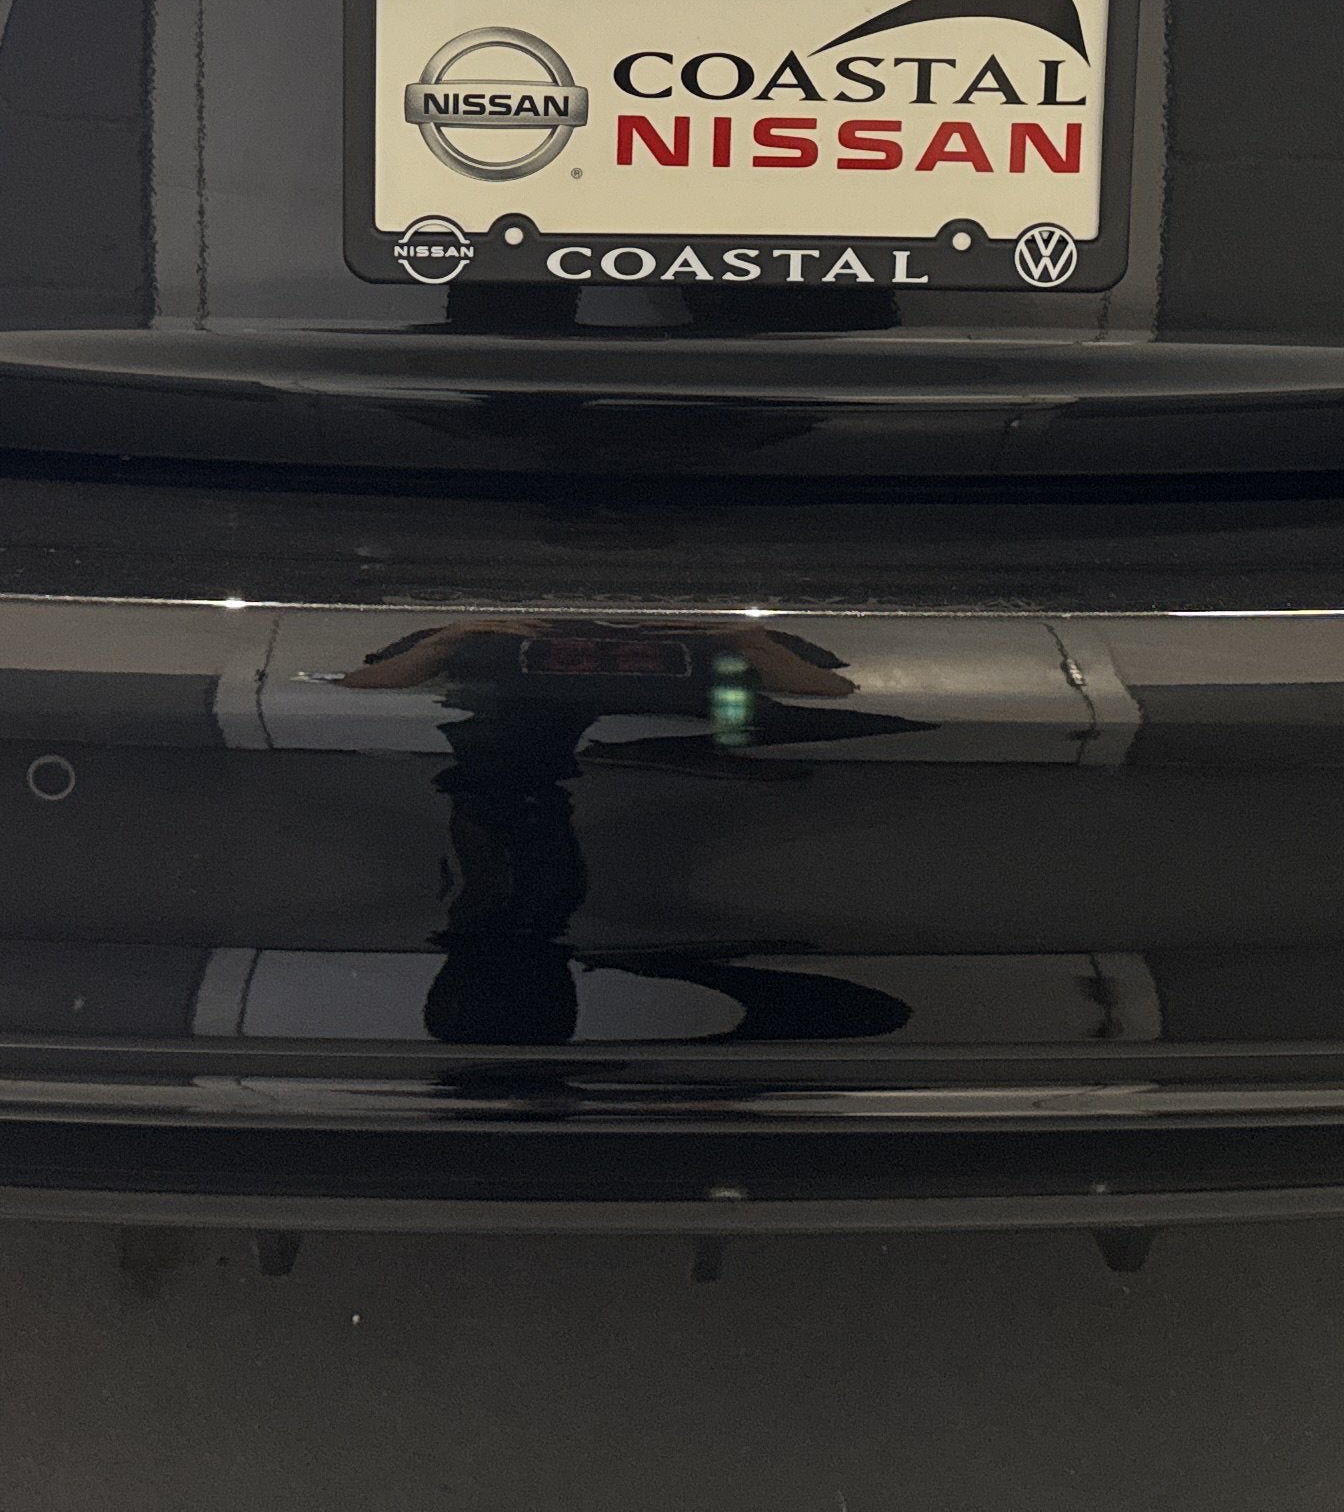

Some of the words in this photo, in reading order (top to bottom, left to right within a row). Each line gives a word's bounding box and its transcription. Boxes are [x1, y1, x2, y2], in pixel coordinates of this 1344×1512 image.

[612, 49, 1088, 106] COASTAL
[421, 90, 570, 117] NISSAN
[615, 114, 1083, 174] NISSAN
[393, 243, 475, 261] NISSAN
[545, 245, 930, 284] COASTAL
